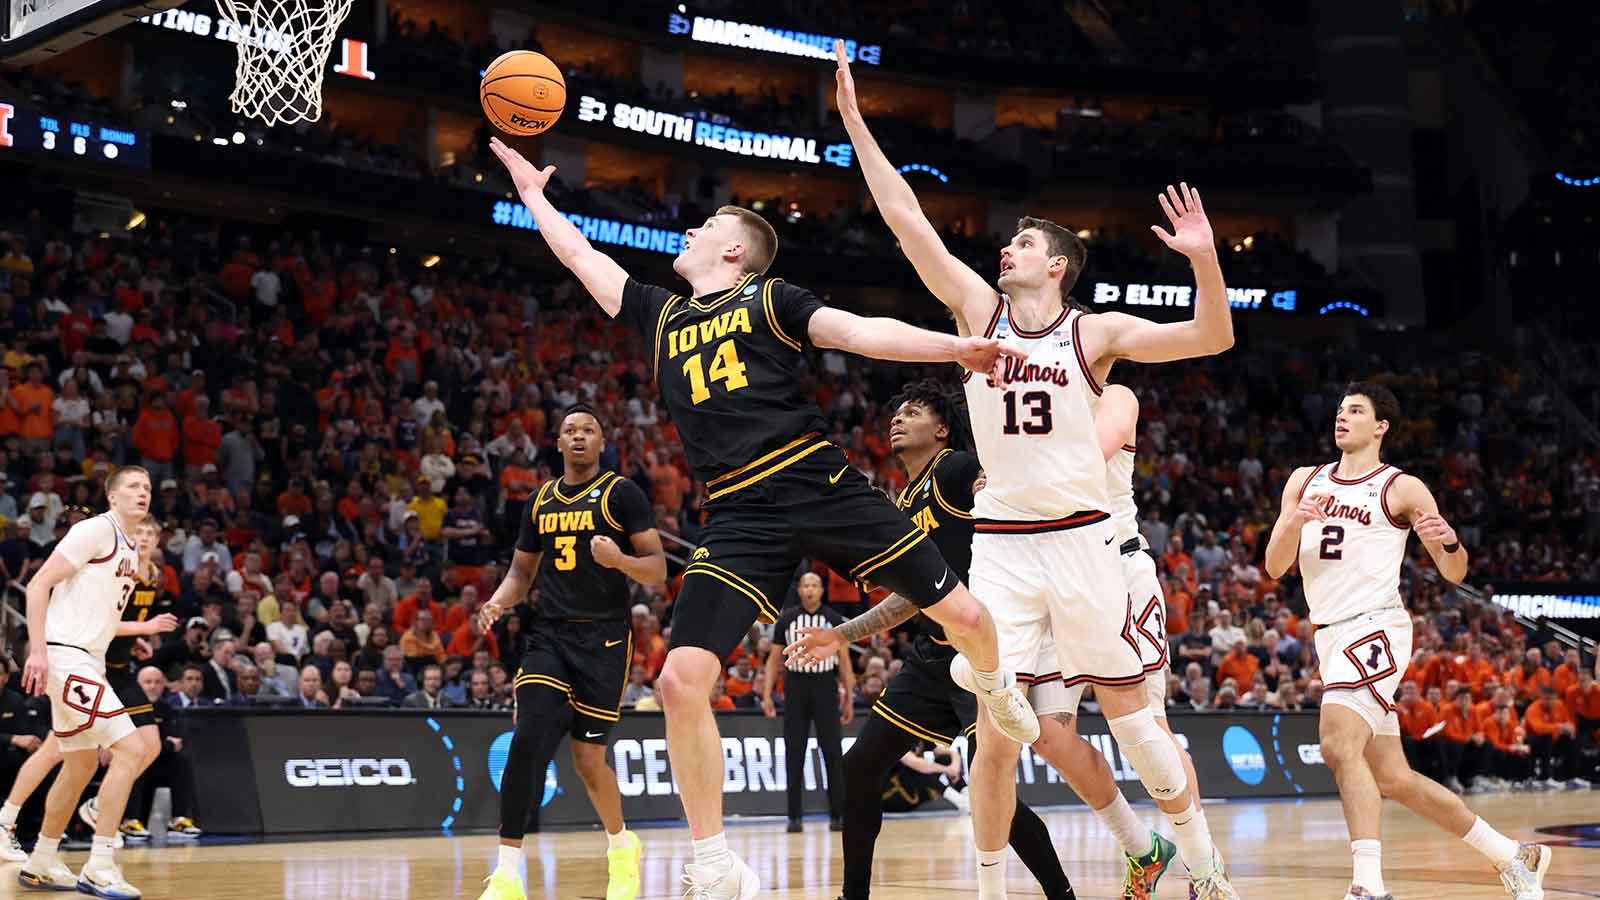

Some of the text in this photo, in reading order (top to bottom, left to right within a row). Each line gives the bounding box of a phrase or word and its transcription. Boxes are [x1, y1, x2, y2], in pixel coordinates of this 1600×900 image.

[43, 131, 56, 149] 3
[613, 103, 821, 164] SOUTH REGIONAL
[1125, 284, 1192, 307] ELITE
[667, 307, 753, 360] IOWA
[682, 338, 749, 406] 14
[986, 354, 1070, 388] llinois
[1002, 390, 1054, 436] 13
[538, 510, 595, 535] IOWA
[1313, 495, 1372, 526] linois
[554, 535, 577, 571] 3
[1319, 524, 1345, 561] 2
[285, 758, 412, 787] GEICO
